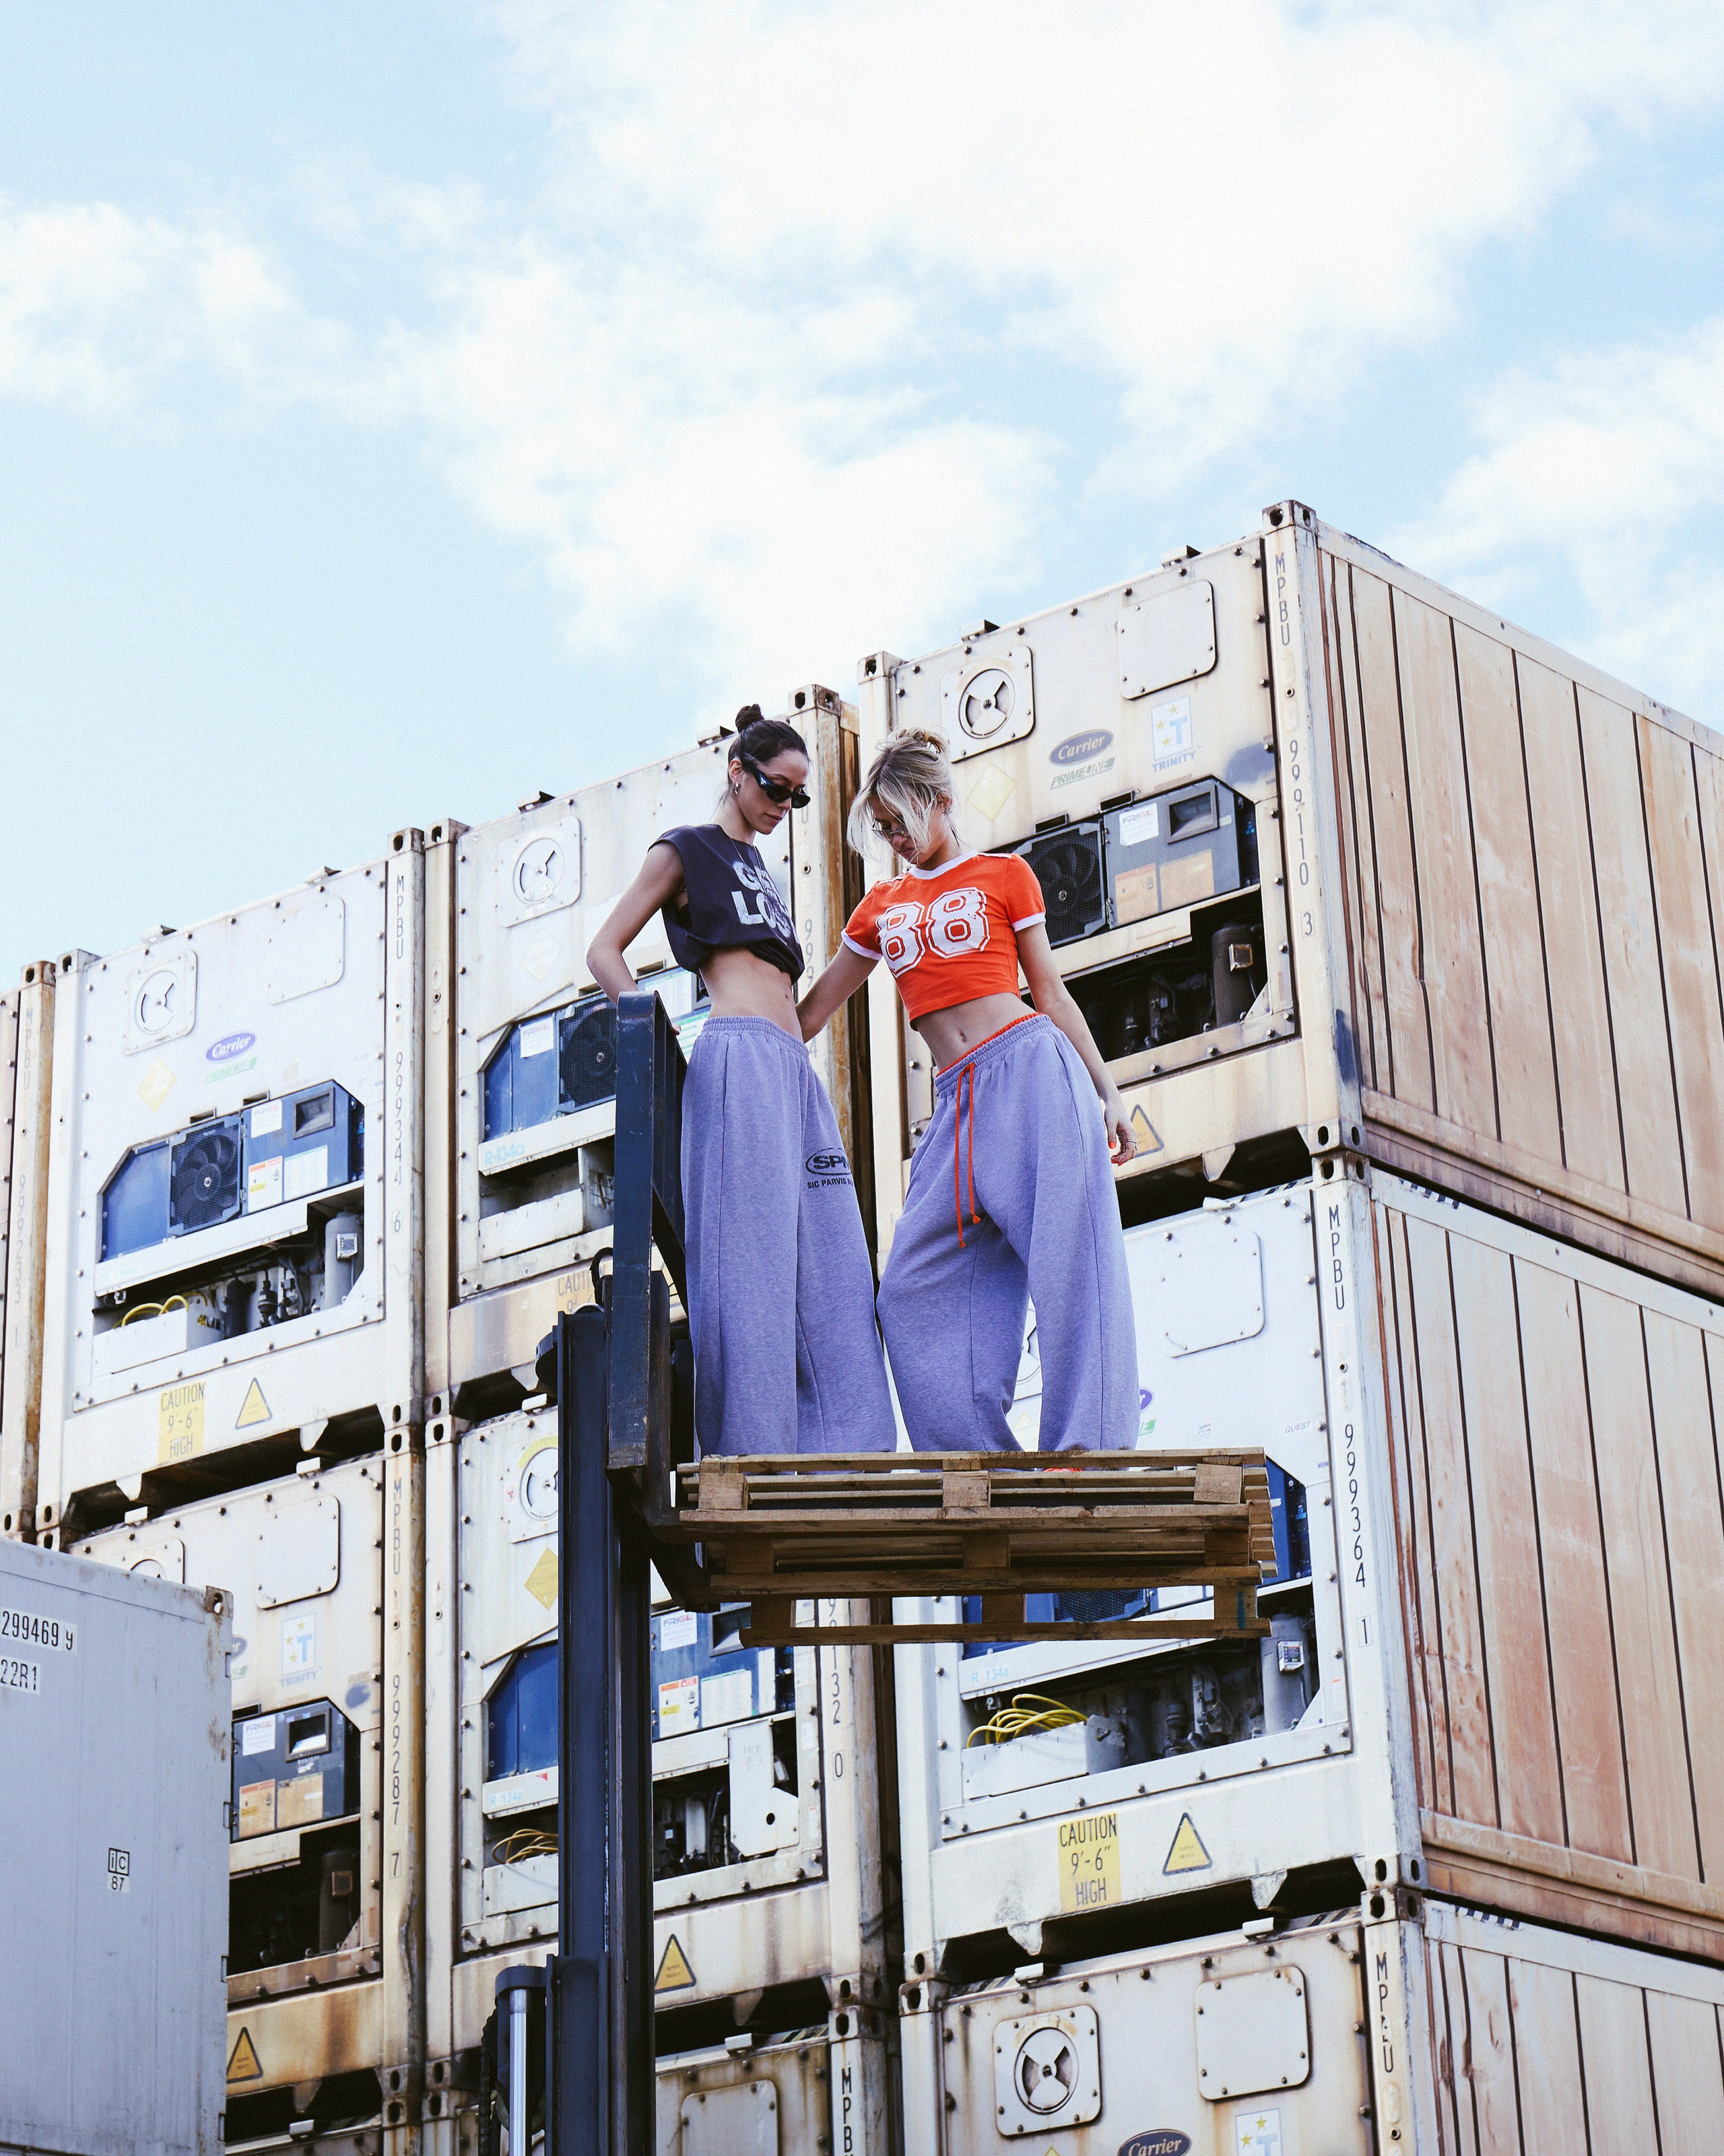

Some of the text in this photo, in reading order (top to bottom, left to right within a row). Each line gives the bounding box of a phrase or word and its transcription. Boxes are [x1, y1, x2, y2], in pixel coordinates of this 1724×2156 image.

[1057, 736, 1106, 760] Carrier
[1275, 552, 1313, 936] MPBU 999110 3
[1152, 750, 1196, 772] TRINITY
[875, 887, 991, 978] 88
[805, 919, 818, 1059] 9994
[24, 1008, 33, 1090] MPBU
[211, 1035, 251, 1059] Carrier
[394, 875, 404, 1233] MPBU 999344 6
[807, 1181, 820, 1189] SIC
[821, 1177, 847, 1187] PARVIS
[161, 1382, 205, 1411] CAUTION
[1284, 1420, 1311, 1433] QUEST
[1329, 1204, 1368, 1644] MPBU 999364 1
[170, 1434, 193, 1459] HIGH
[2, 1610, 59, 1647] 299469
[1, 1659, 37, 1691] 22R1
[279, 1670, 317, 1687] TRINITY
[392, 1478, 402, 1876] MPBU 999287 7
[972, 1672, 980, 1683] R
[834, 1753, 842, 1777] 0
[1059, 1813, 1118, 1847] CAUTION
[111, 1875, 125, 1891] 87
[1075, 1878, 1107, 1906] HIGH
[842, 2066, 853, 2156] MPB
[1127, 2138, 1183, 2156] Carrier
